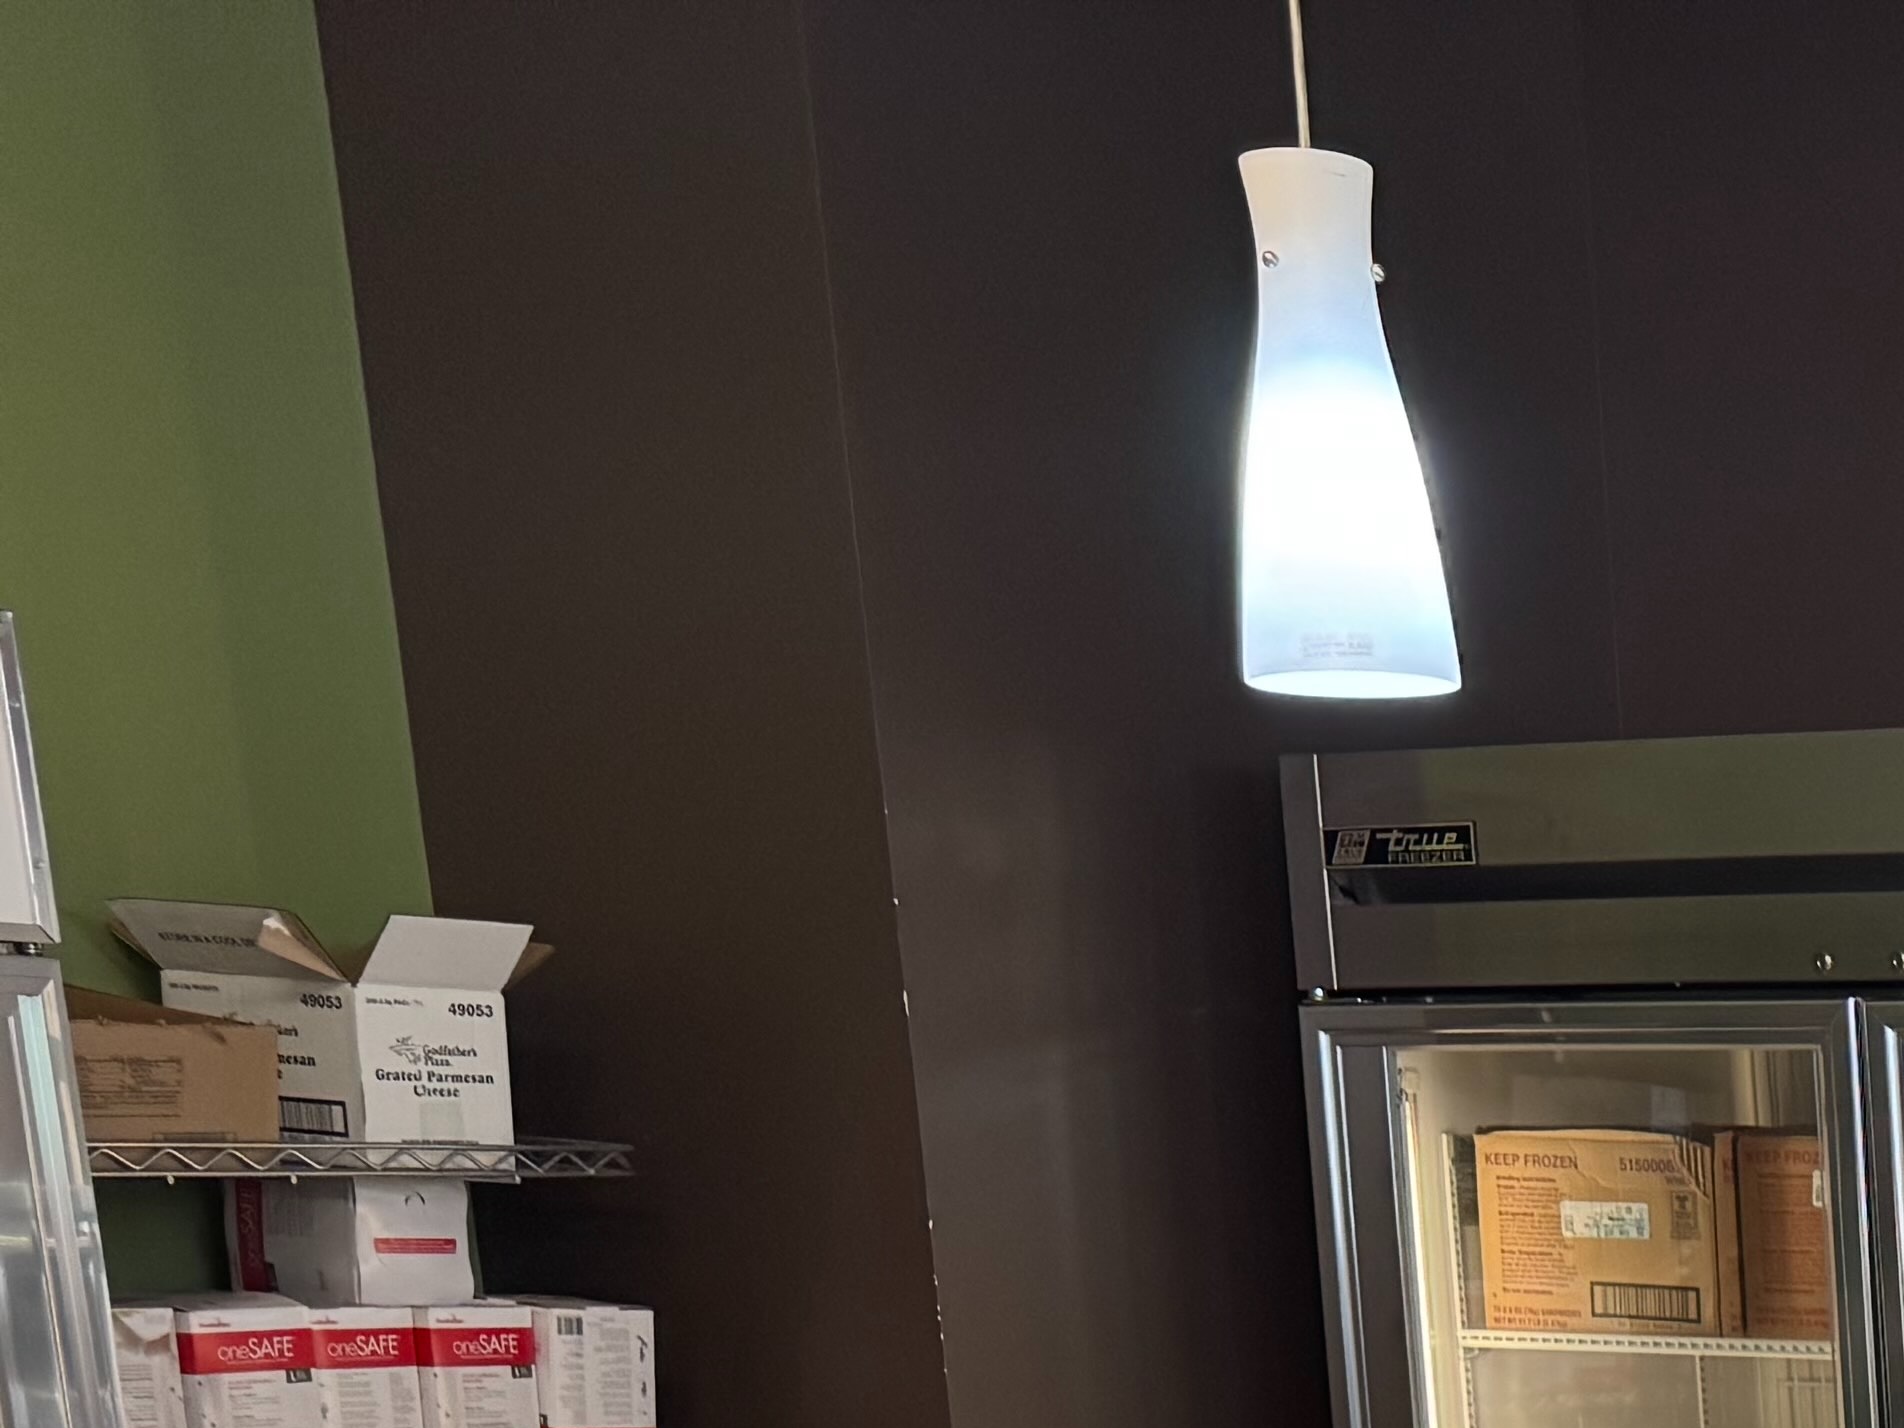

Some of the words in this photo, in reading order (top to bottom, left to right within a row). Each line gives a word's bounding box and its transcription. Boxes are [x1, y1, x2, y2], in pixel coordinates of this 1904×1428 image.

[300, 993, 342, 1009] 49053
[448, 1003, 494, 1019] 49053
[375, 1068, 422, 1083] Grated
[426, 1070, 495, 1085] Parmesan
[1485, 1152, 1520, 1167] KEEP
[1524, 1154, 1578, 1170] FROZEN
[218, 1336, 294, 1362] oneSAFE
[452, 1333, 518, 1356] oneSAFE
